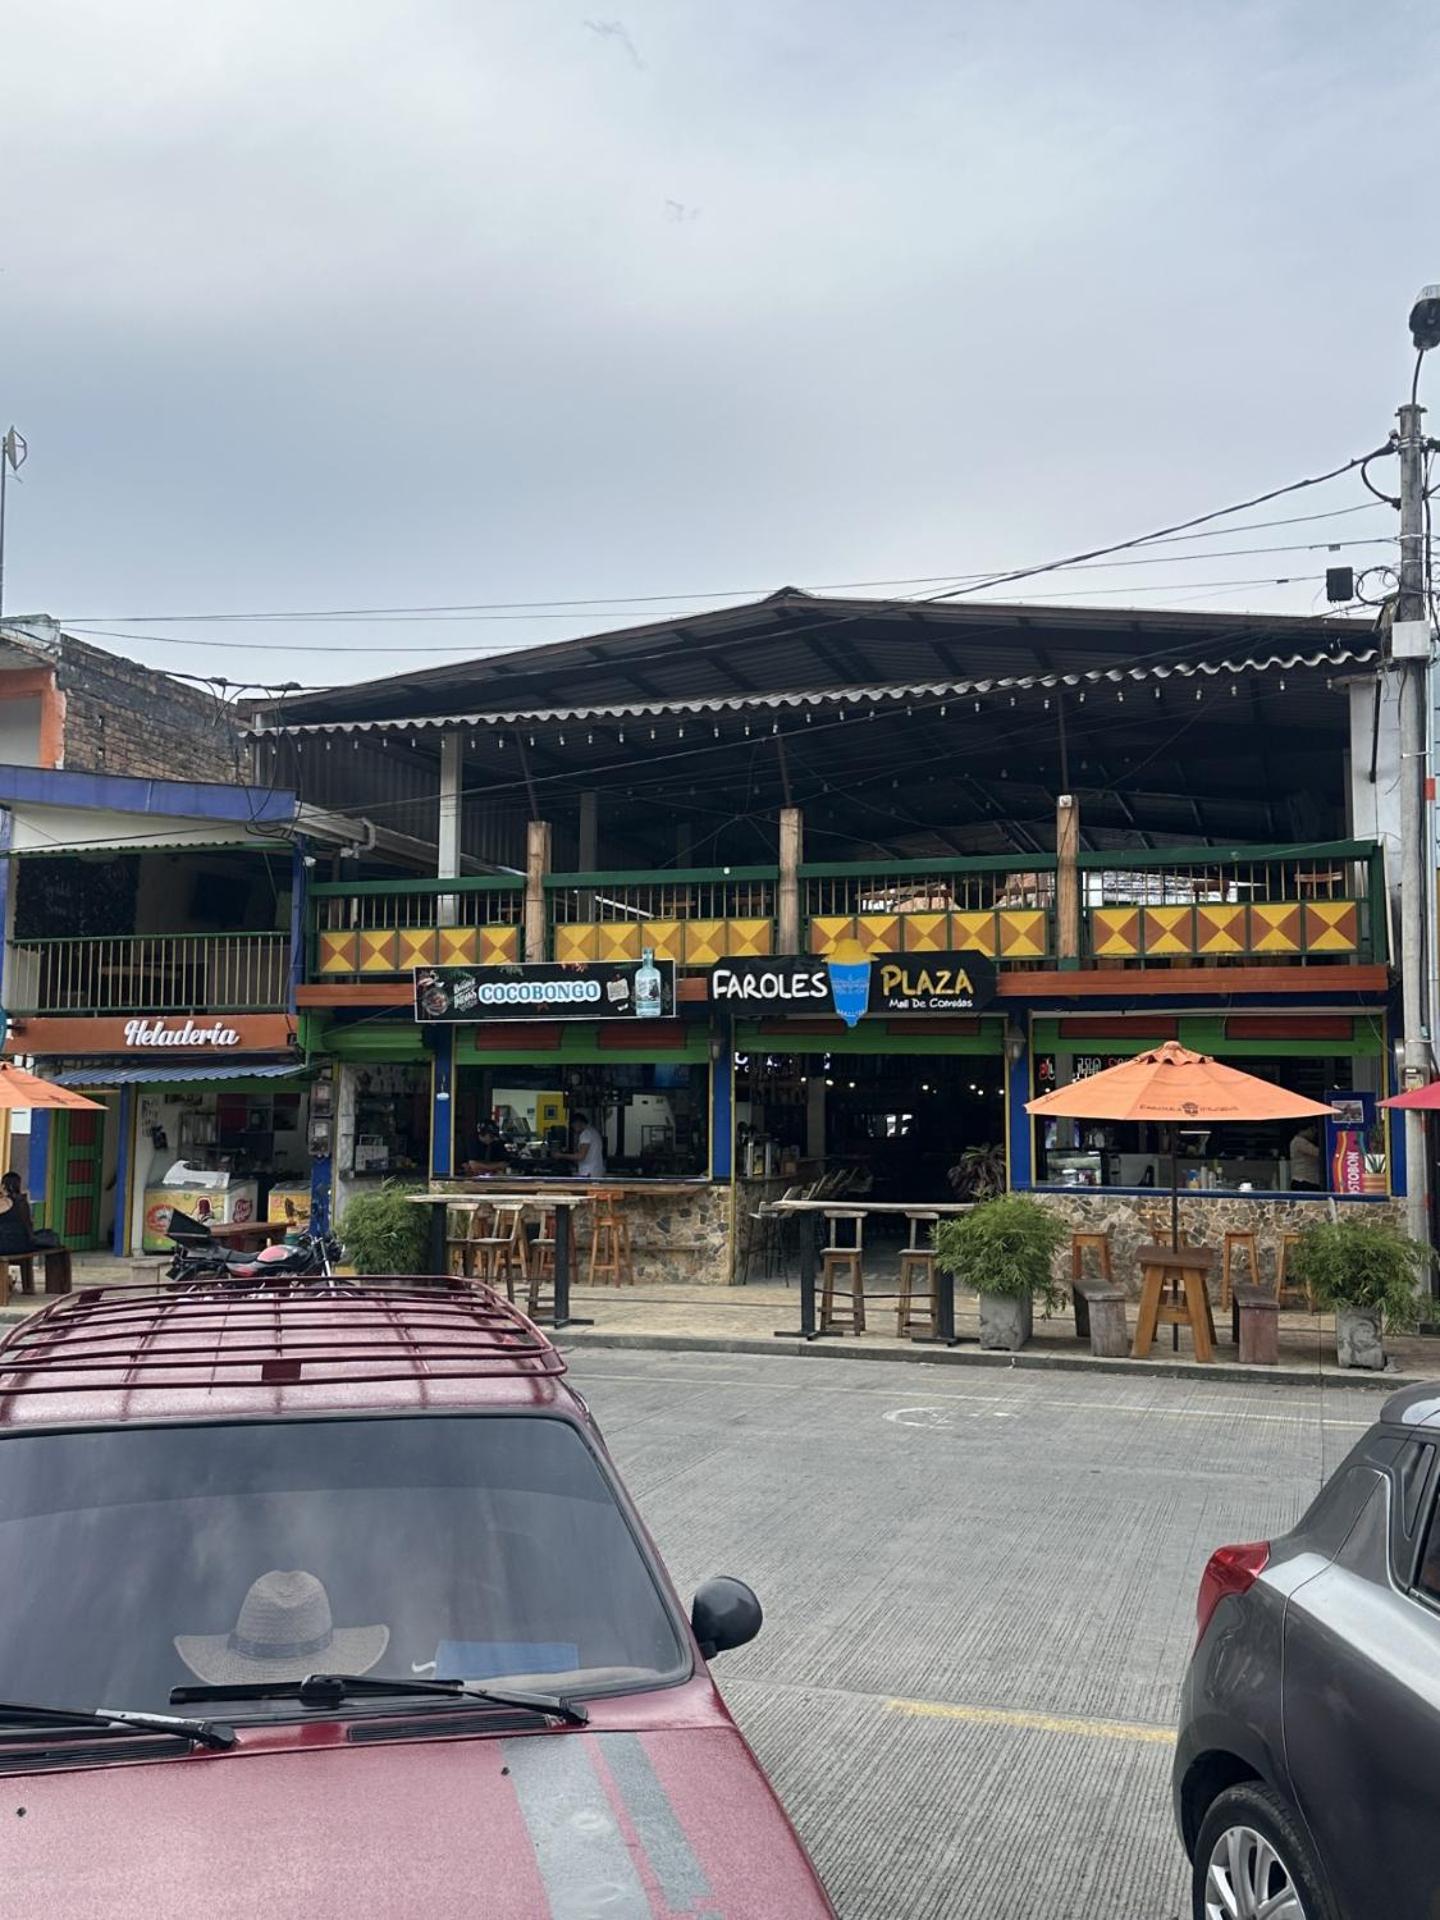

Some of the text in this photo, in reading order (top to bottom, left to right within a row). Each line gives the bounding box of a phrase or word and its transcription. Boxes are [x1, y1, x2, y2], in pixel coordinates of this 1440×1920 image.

[480, 982, 600, 1003] COCOBONGO
[712, 969, 828, 999] FAROLES
[880, 964, 974, 996] PLAZA
[888, 997, 974, 1009] Mall De Comidas
[1346, 1152, 1361, 1194] STOBON
